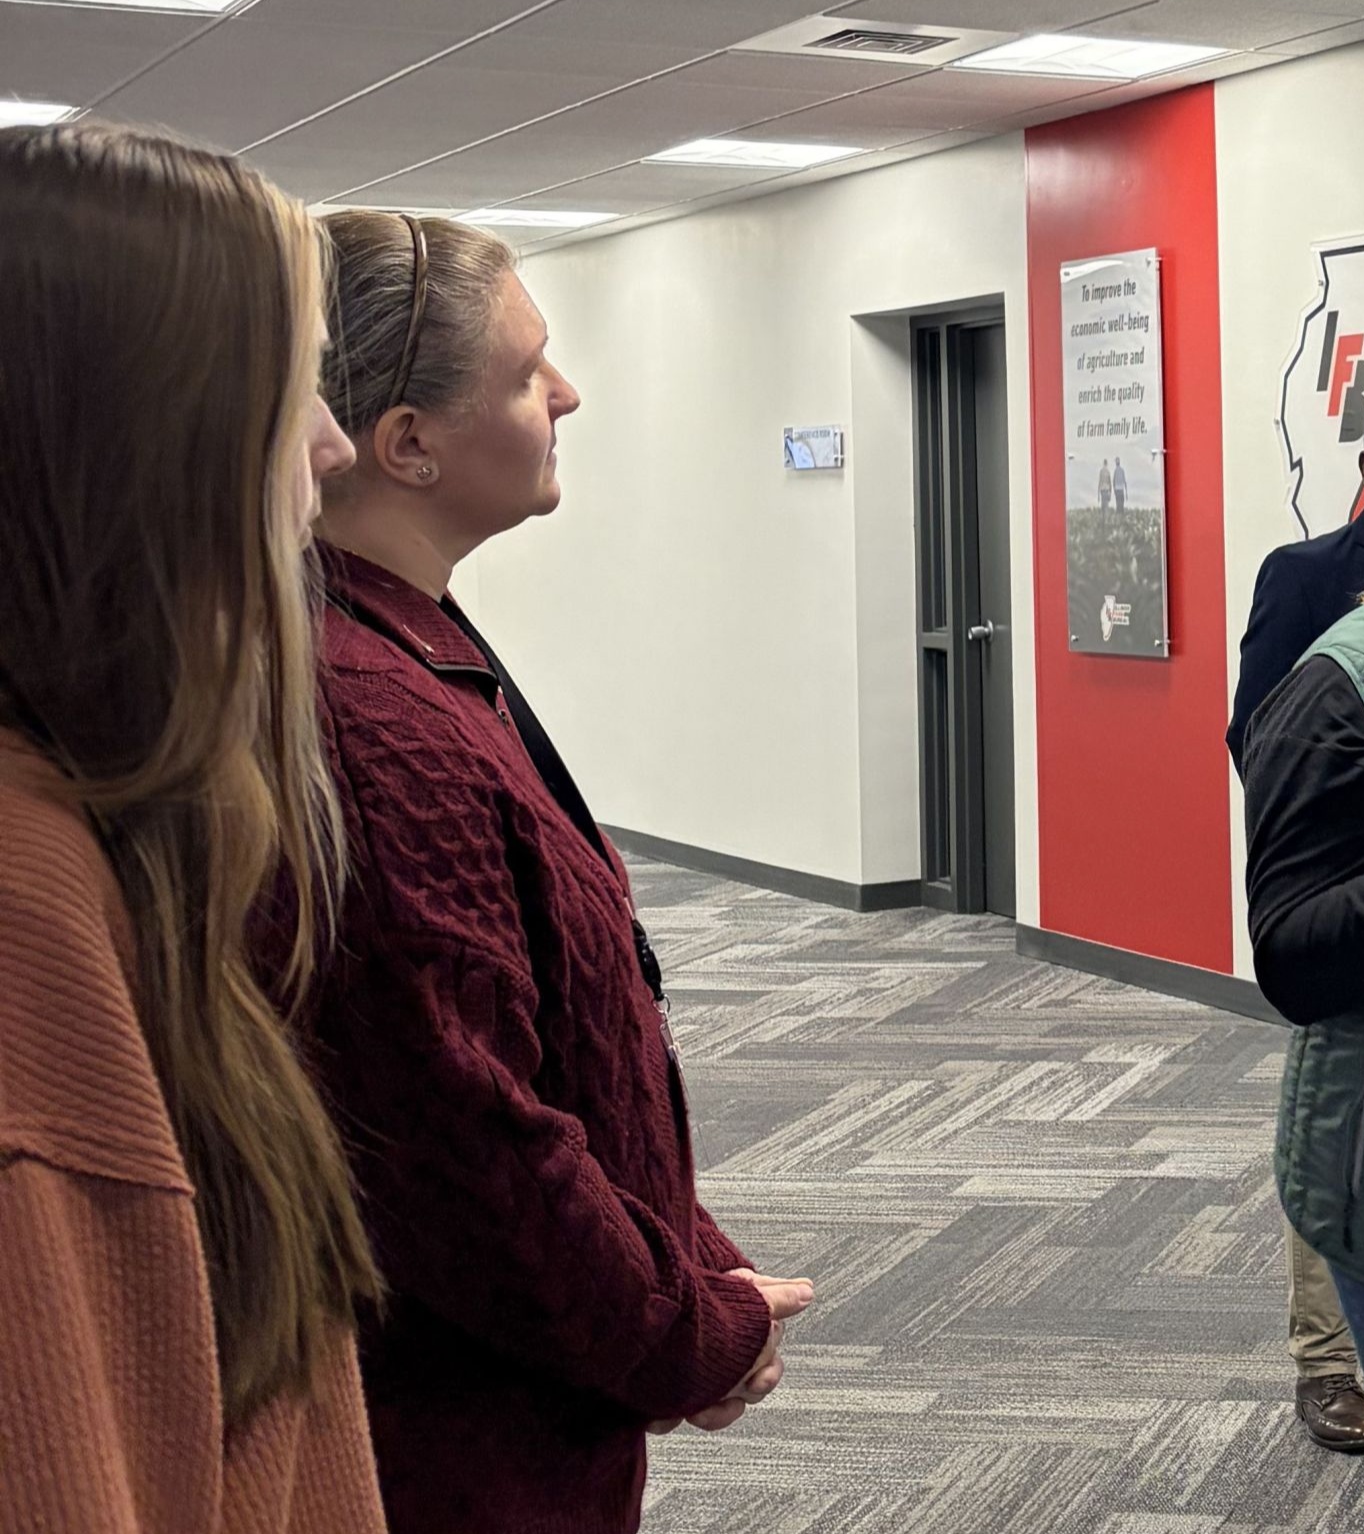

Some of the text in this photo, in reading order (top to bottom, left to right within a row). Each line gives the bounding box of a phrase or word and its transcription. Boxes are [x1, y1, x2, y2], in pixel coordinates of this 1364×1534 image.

[1082, 278, 1136, 304] To improve the
[1071, 312, 1149, 337] economic well-being
[1077, 347, 1144, 373] of agriculture and
[1078, 381, 1145, 405] enrich the quality
[1077, 416, 1148, 439] of farm family life.
